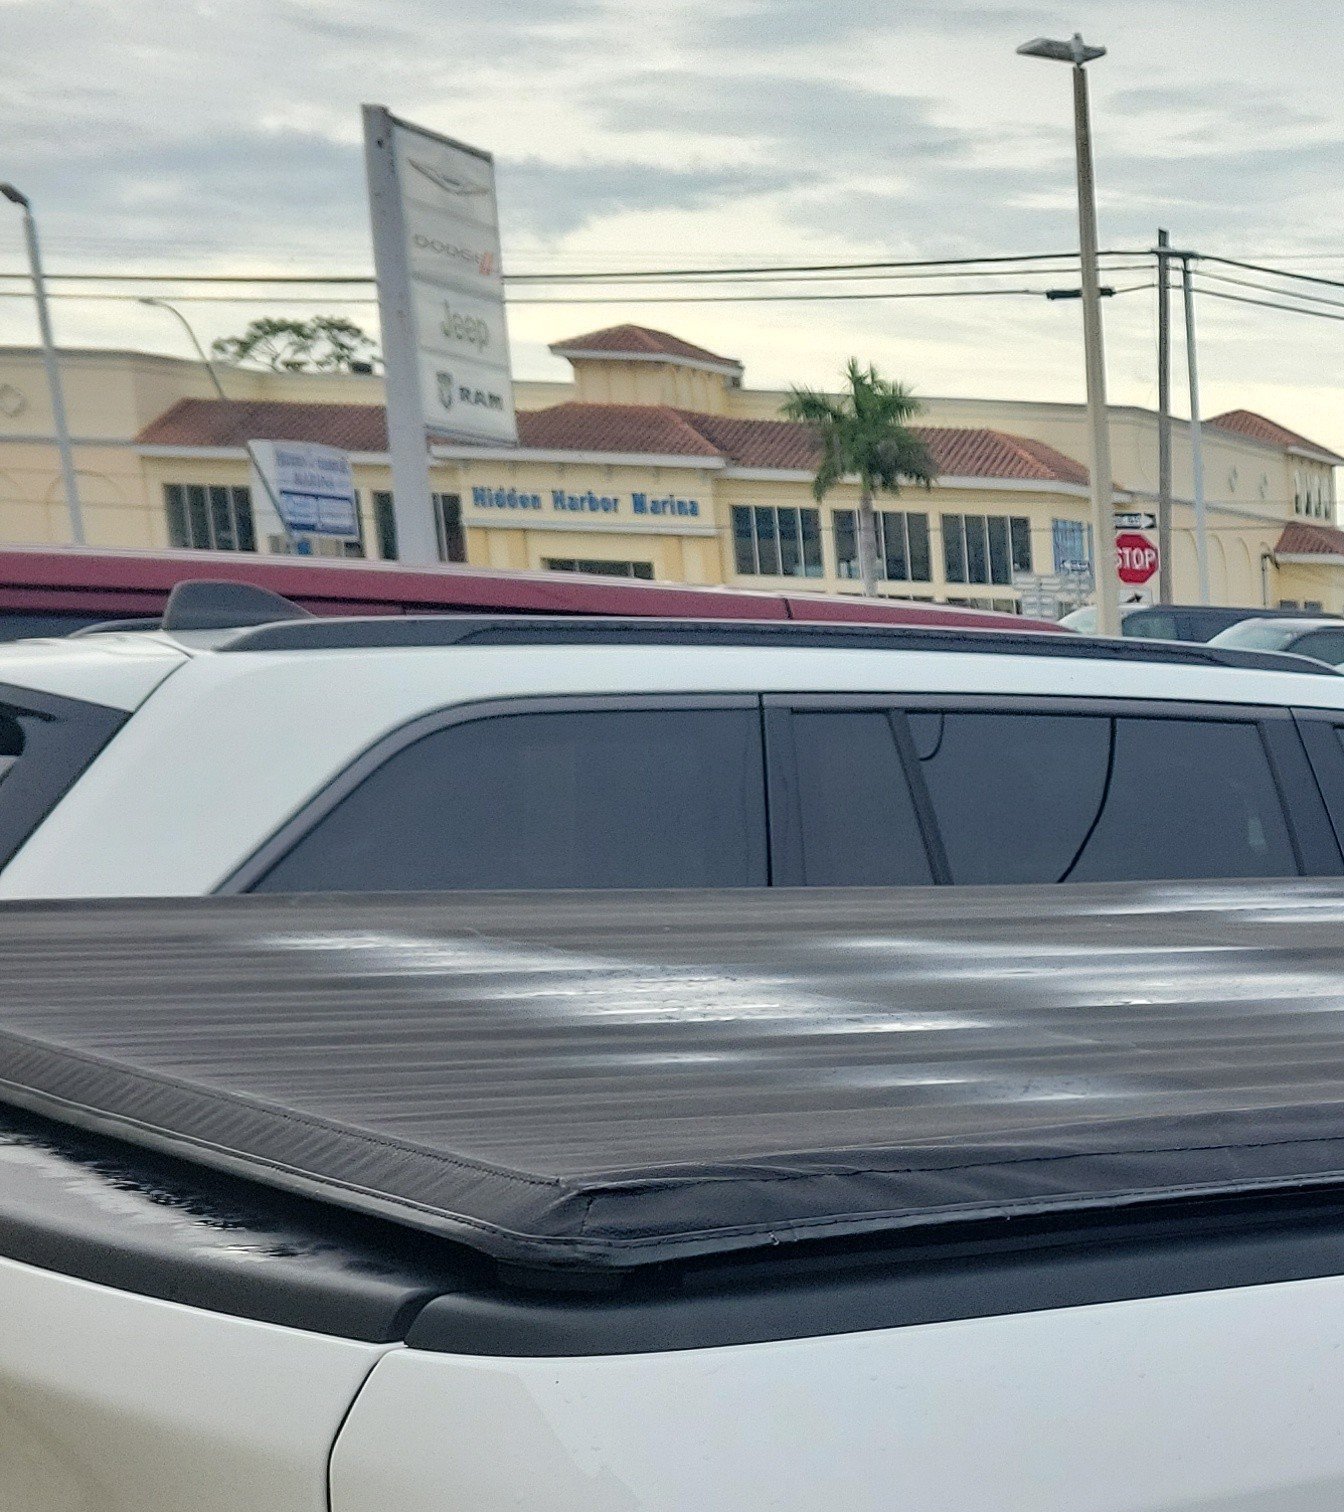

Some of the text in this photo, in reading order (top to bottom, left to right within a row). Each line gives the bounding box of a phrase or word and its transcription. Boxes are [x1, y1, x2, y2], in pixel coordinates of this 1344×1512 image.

[441, 299, 488, 352] Jeep
[459, 386, 503, 410] RAM
[472, 486, 698, 516] Hidden Harbor Marina
